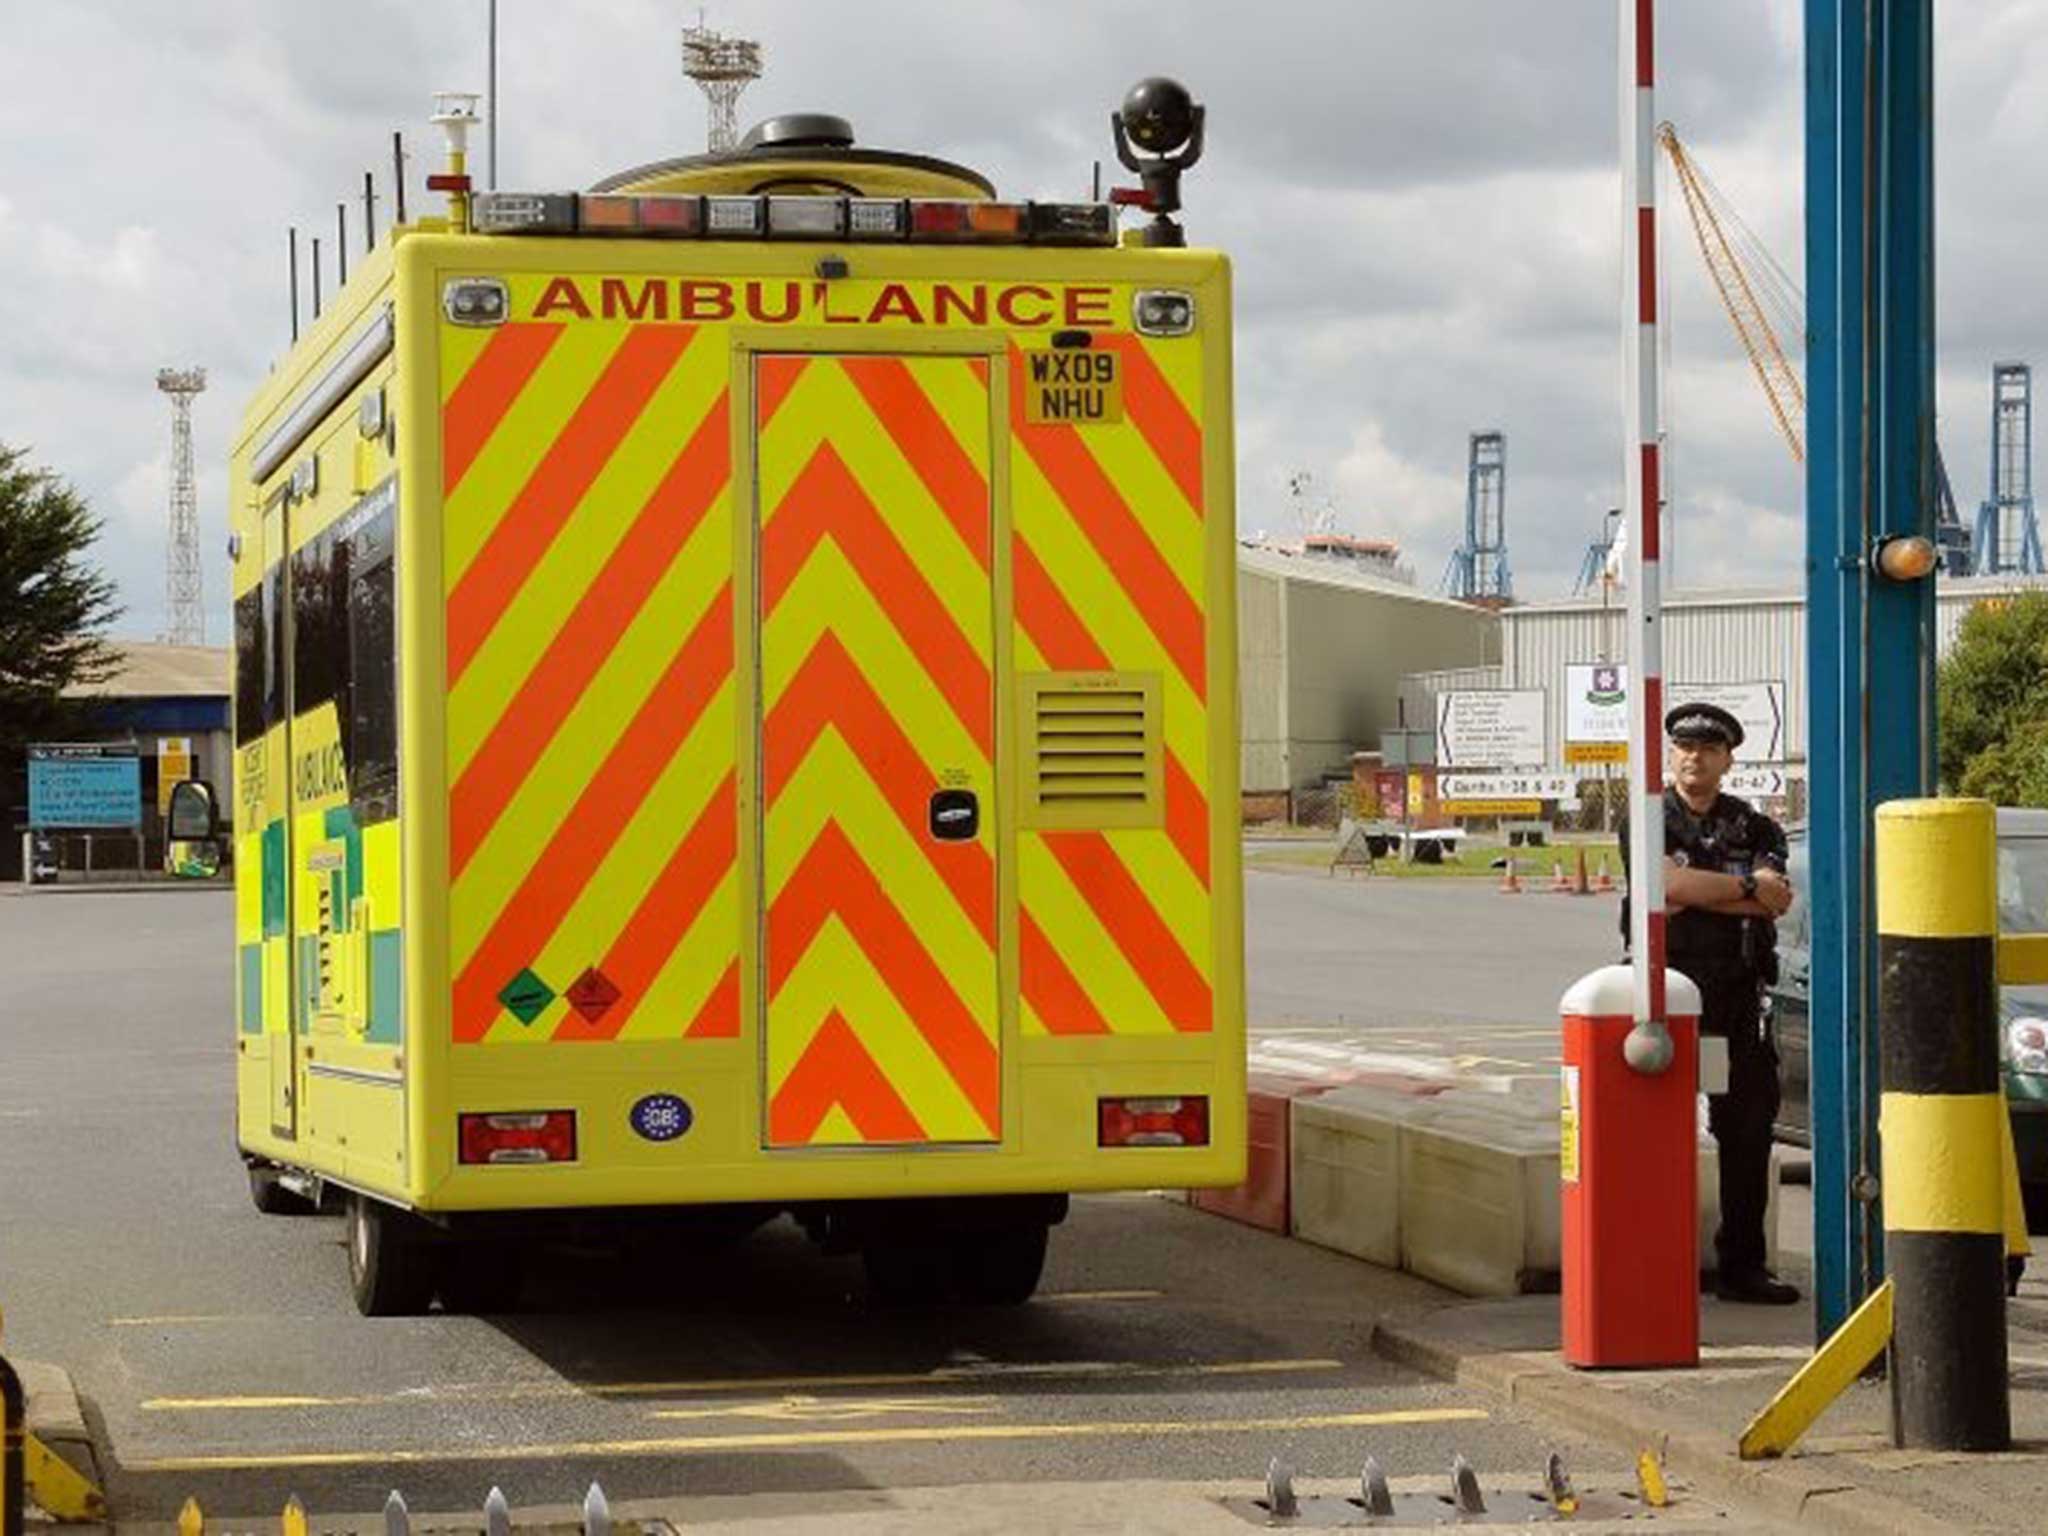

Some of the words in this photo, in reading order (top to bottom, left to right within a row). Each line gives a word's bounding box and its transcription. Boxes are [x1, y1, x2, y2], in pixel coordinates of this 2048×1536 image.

[532, 277, 1113, 326] AMBULANCE
[1031, 353, 1113, 383] WX09
[1042, 388, 1103, 418] NHU
[650, 1109, 672, 1127] GB
